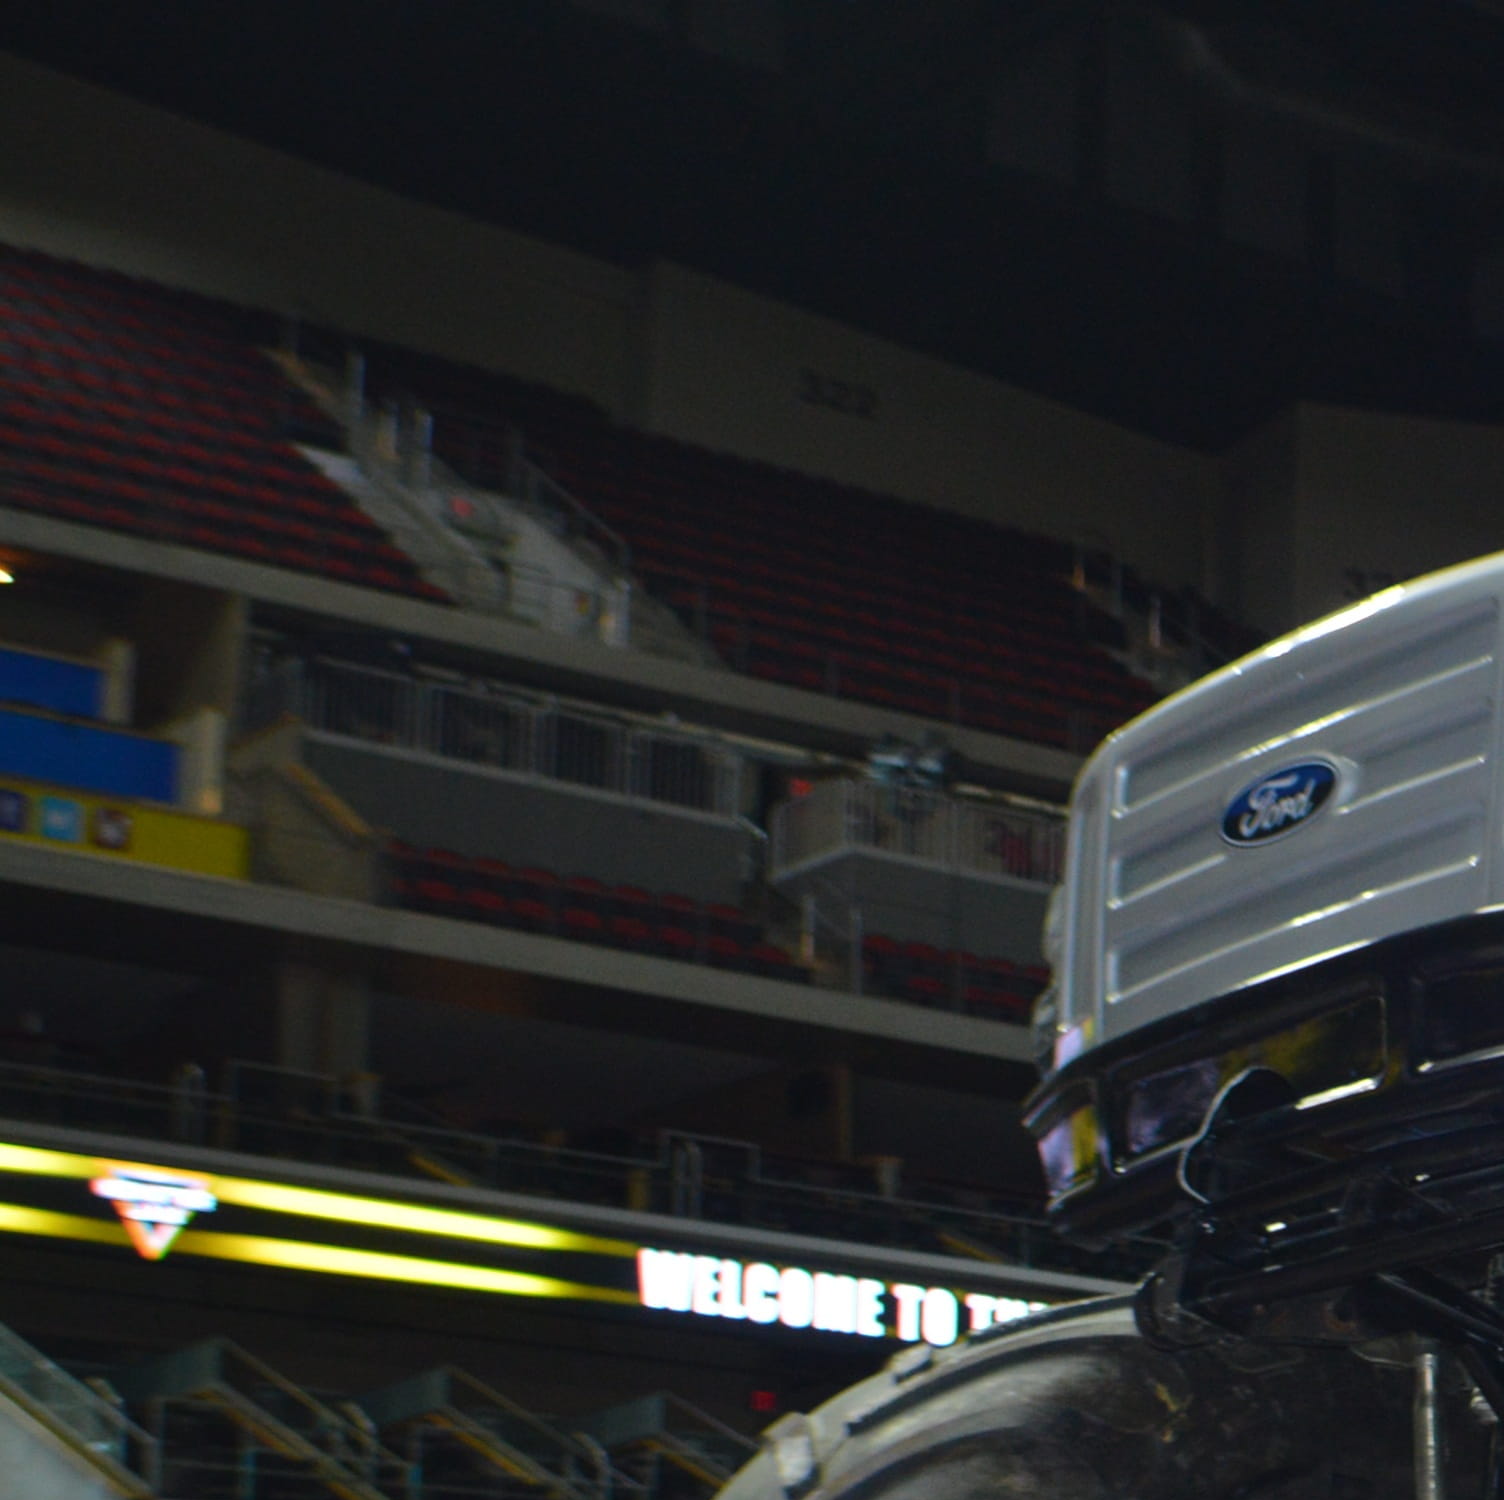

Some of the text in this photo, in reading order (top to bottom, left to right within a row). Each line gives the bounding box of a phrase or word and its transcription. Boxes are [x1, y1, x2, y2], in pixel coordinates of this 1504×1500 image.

[1239, 773, 1317, 839] Ford
[637, 1246, 886, 1338] WELCOME
[892, 1282, 959, 1347] TO
